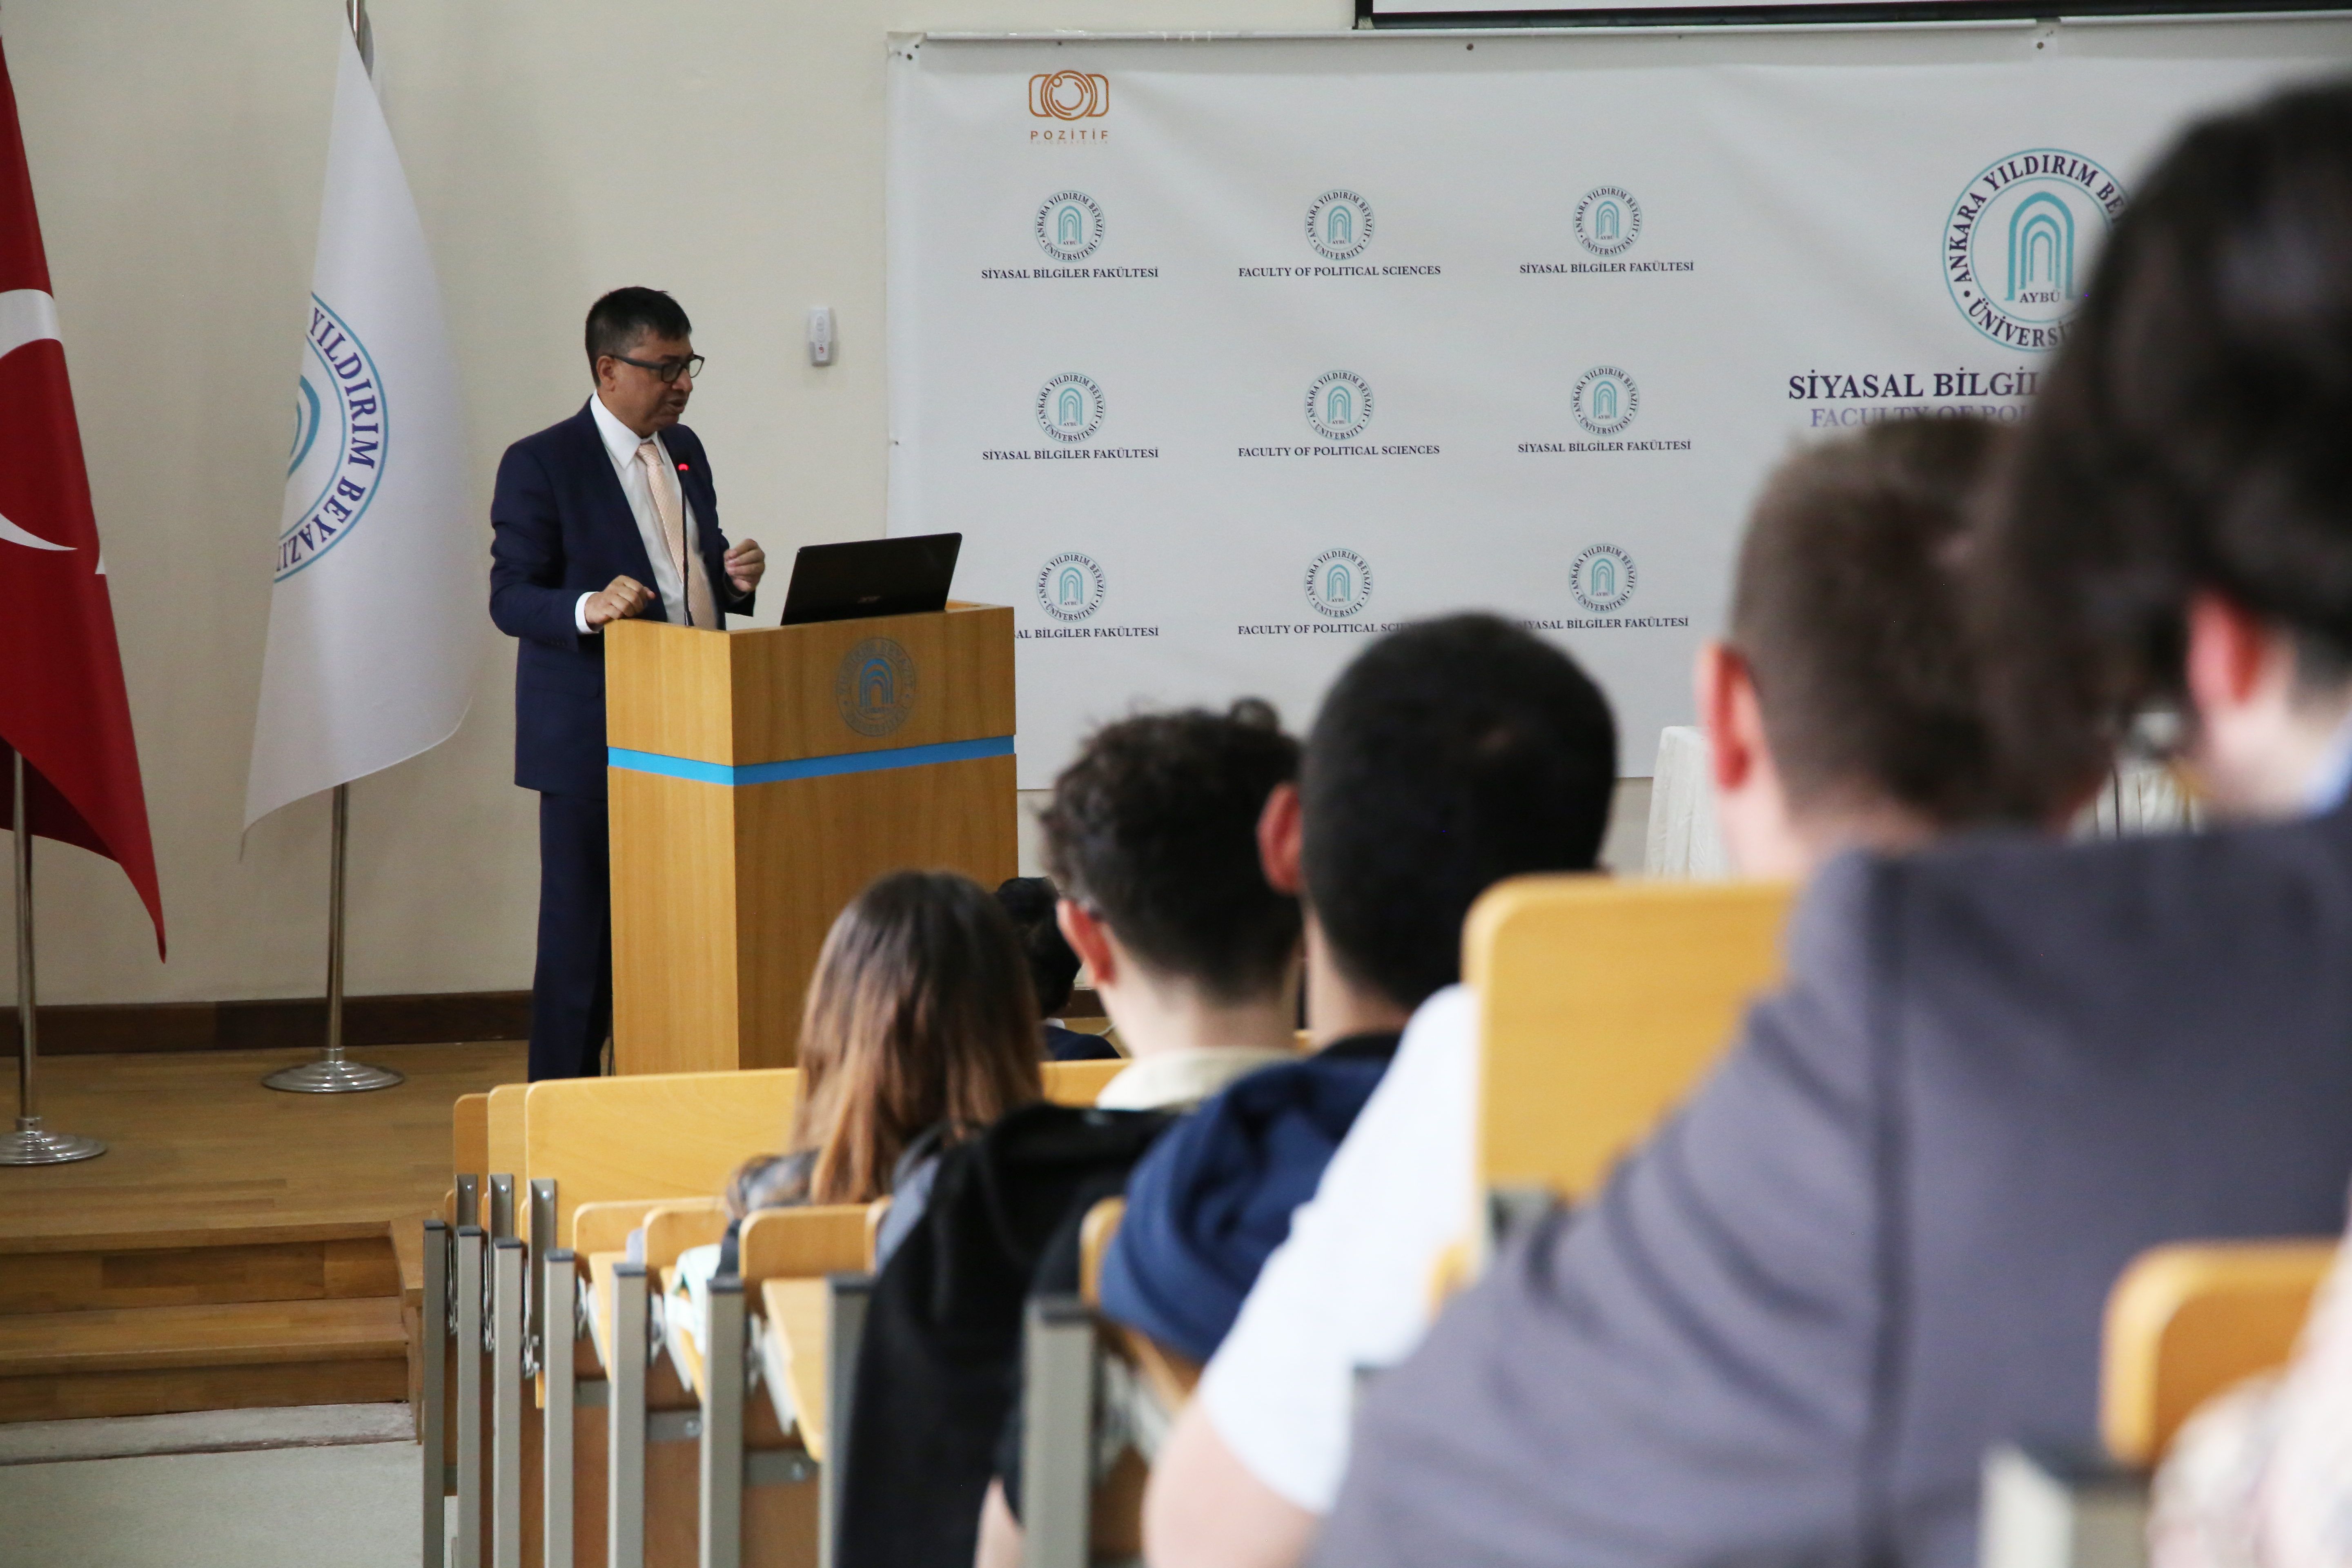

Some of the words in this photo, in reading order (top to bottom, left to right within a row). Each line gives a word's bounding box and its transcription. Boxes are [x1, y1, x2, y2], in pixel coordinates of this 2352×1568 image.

[1030, 128, 1108, 140] POZİTİF
[1037, 206, 1050, 237] ANKARA
[1049, 193, 1089, 205] YILDIRIM
[1089, 203, 1102, 238] BEYAZIT
[1307, 205, 1320, 237] ANKARA
[1319, 192, 1359, 204] YILDIRIM
[1359, 202, 1372, 238] BEYAZIT
[1575, 201, 1588, 232] ANKARA
[1587, 188, 1626, 200] YILDIRIM
[1626, 197, 1639, 232] BEYAZIT
[1949, 192, 1987, 282] ANKARA
[1983, 154, 2099, 192] YILDIRIM
[1315, 243, 1364, 259] UNIVERSITY
[981, 267, 1031, 279] SİYASAL
[1033, 267, 1091, 278] BİLGİLER
[1093, 266, 1159, 278] FAKÜLTESİ
[1238, 267, 1292, 277] FACULTY
[1294, 267, 1312, 276] OF
[1314, 266, 1379, 276] POLITICAL
[1382, 265, 1441, 276] SCIENCES
[1519, 263, 1568, 274] SİYASAL
[1570, 261, 1626, 273] BİLGİLER
[1629, 260, 1694, 272] FAKÜLTESİ
[2020, 290, 2060, 303] AYBÜ
[1969, 298, 2067, 347] ÜNİVERSİ
[310, 307, 379, 469] YILDIRIM
[1573, 381, 1586, 412] ANKARA
[1585, 368, 1624, 380] YILDIRIM
[1624, 377, 1637, 412] BEYAZIT
[1788, 370, 1924, 399] SİYASAL
[1933, 367, 2039, 398] BİLGİ
[1038, 388, 1051, 419] ANKARA
[1049, 374, 1089, 387] YILDIRIM
[1089, 384, 1103, 419] BEYAZIT
[1307, 385, 1319, 417] ANKARA
[1318, 372, 1359, 385] YILDIRIM
[1358, 383, 1372, 418] BEYAZIT
[1315, 423, 1363, 439] UNIVERSITY
[982, 449, 1031, 461] SİYASAL
[1033, 448, 1091, 460] BİLGİLER
[1094, 447, 1159, 459] FAKÜLTESİ
[1238, 447, 1291, 457] FACULTY
[1294, 447, 1311, 456] OF
[1313, 446, 1379, 456] POLITICAL
[1381, 445, 1440, 455] SCIENCES
[1518, 442, 1566, 453] SİYASAL
[1568, 441, 1624, 452] BİLGİLER
[1627, 439, 1691, 451] FAKÜLTESİ
[1307, 564, 1319, 596] ANKARA
[1318, 551, 1357, 563] YILDIRIM
[1357, 561, 1371, 596] BEYAZIT
[1571, 559, 1584, 590] ANKARA
[1583, 546, 1622, 558] YILDIRIM
[1621, 555, 1635, 590] BEYAZIT
[1039, 567, 1051, 599] ANKARA
[1050, 555, 1090, 567] YILDIRIM
[1089, 564, 1103, 599] BEYAZIT
[1314, 601, 1363, 617] UNIVERSITY
[1238, 625, 1291, 635] FACULTY
[1294, 624, 1310, 634] OF
[1313, 624, 1378, 634] POLITICAL
[1523, 619, 1564, 630] YASAL
[1566, 617, 1622, 629] BİLGİLER
[1625, 617, 1689, 628] FAKÜLTESİ
[1034, 627, 1091, 639] BİLGİLER
[1094, 625, 1159, 637] FAKÜLTESİ
